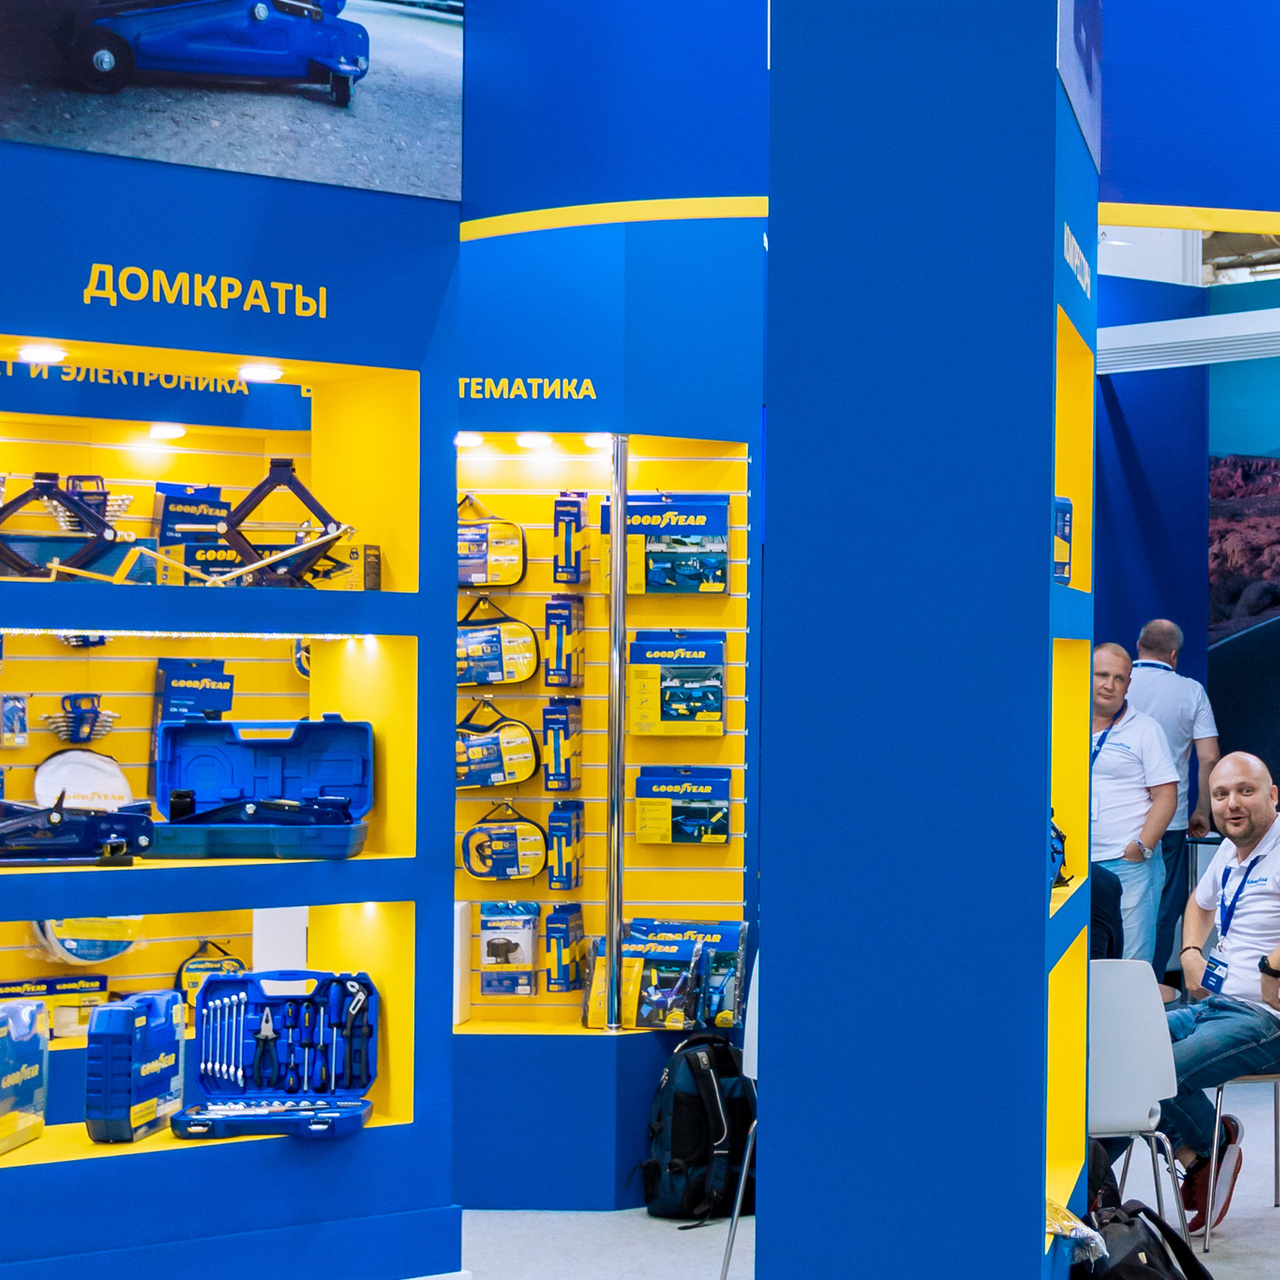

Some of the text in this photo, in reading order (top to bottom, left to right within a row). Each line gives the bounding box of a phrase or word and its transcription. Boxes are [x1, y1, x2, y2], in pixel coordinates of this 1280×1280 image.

[83, 262, 328, 319] ДОМКРАТЫ
[168, 503, 229, 519] GOODYEAR
[646, 648, 706, 661] GOODYEAR
[170, 678, 231, 691] GOODYEAR
[652, 782, 712, 795] GOODYEAR
[56, 980, 101, 991] GOODYEAR
